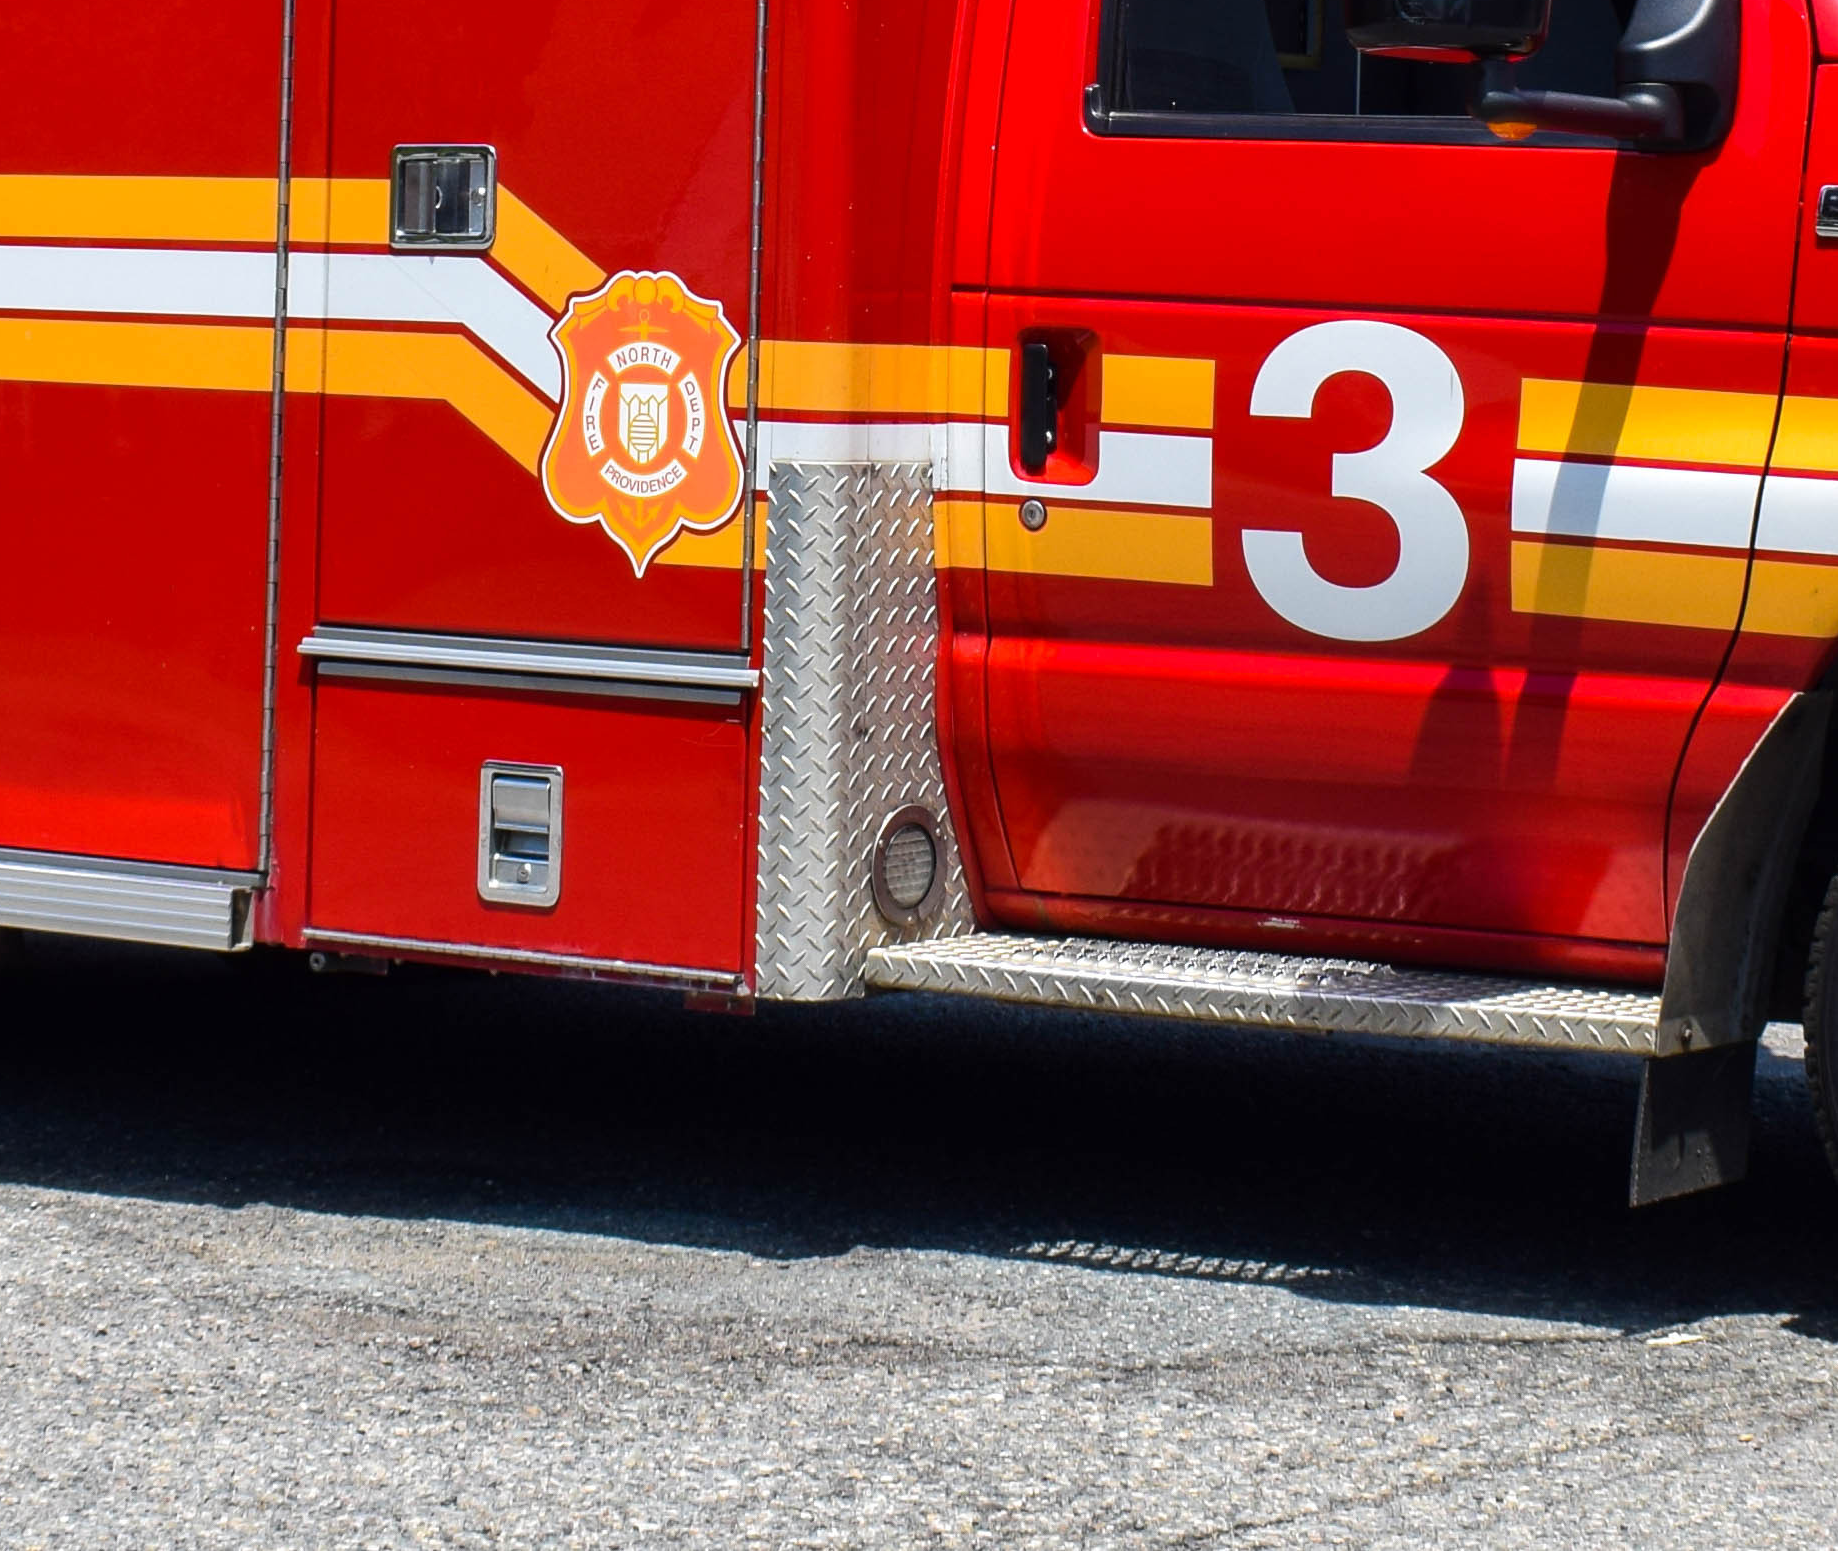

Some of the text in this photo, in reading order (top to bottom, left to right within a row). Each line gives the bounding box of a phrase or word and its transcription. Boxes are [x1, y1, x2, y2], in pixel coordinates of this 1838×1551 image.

[616, 345, 673, 370] NORTH
[586, 376, 606, 452] FIRE
[604, 464, 684, 495] PROVIDENCE
[1241, 319, 1470, 643] 3
